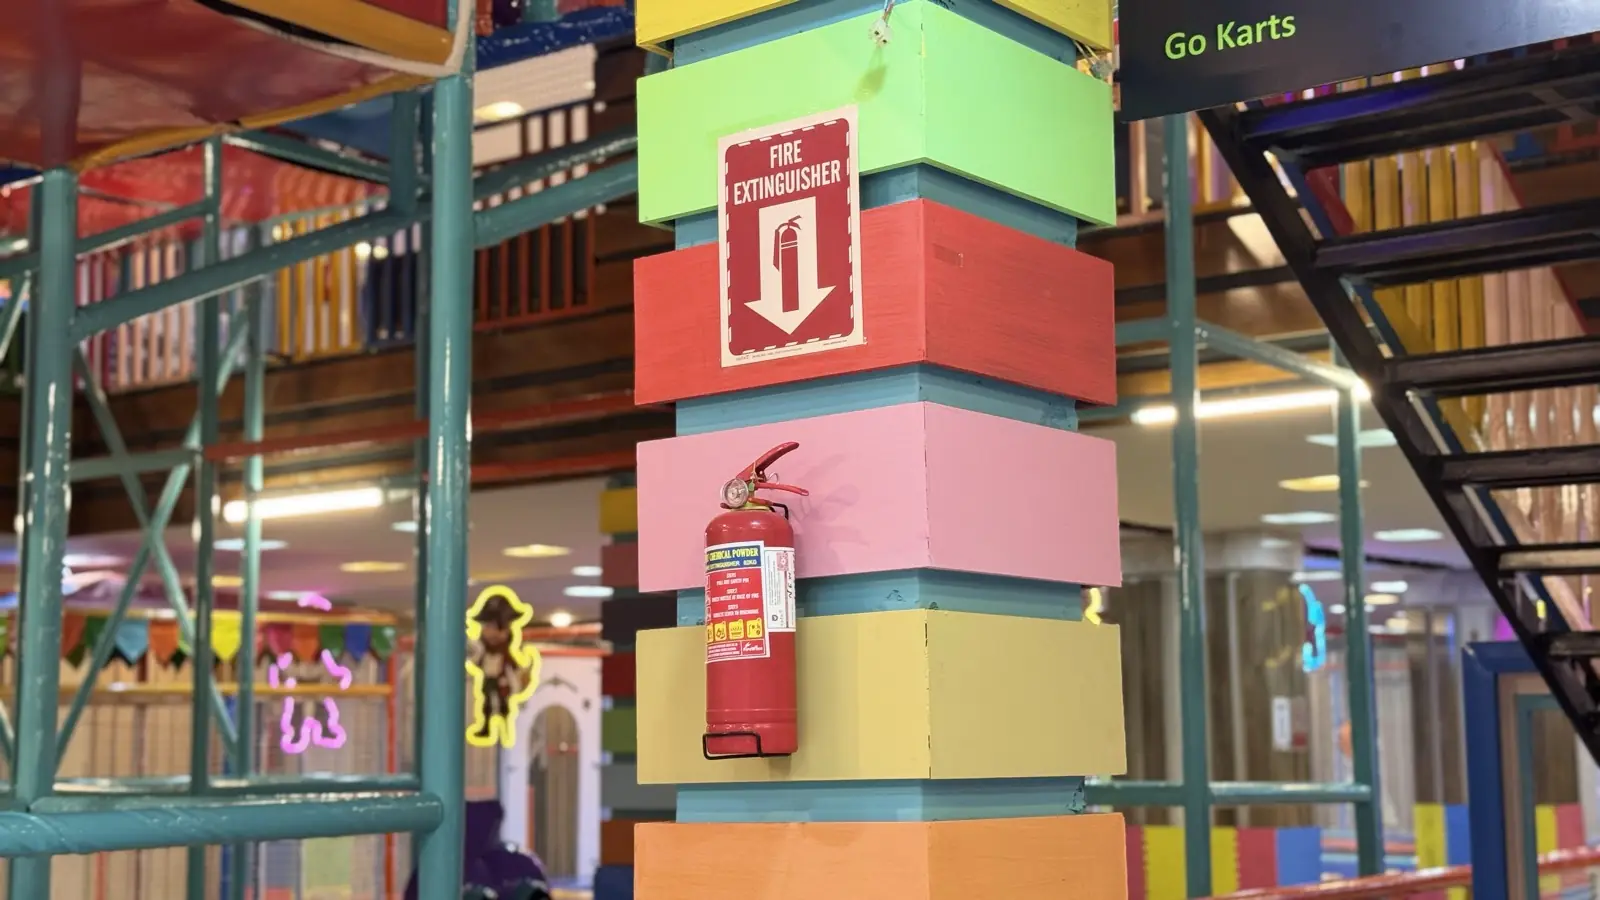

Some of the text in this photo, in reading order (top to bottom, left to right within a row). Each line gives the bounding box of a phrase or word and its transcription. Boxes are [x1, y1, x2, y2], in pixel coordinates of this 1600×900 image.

[1165, 15, 1296, 60] Go Karts
[770, 139, 802, 168] FIRE
[734, 160, 840, 205] EXTINGUISHER
[732, 547, 759, 558] POWDER
